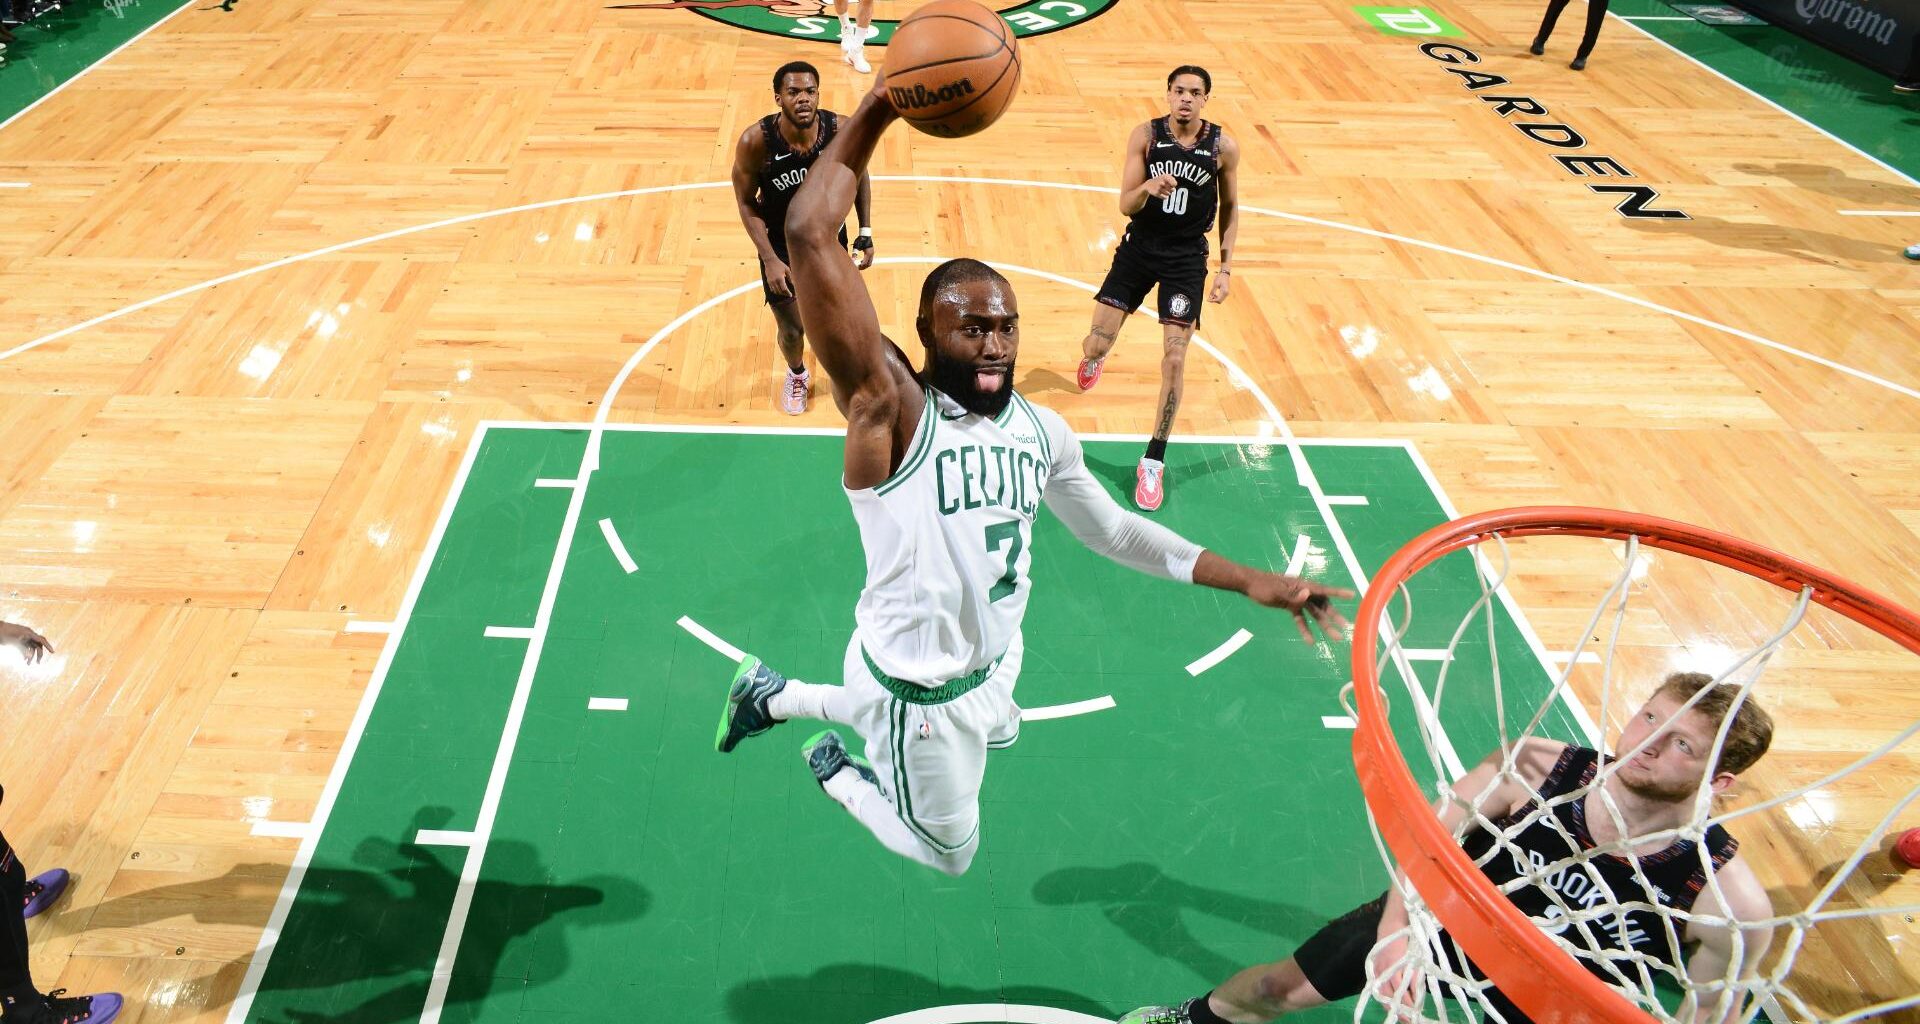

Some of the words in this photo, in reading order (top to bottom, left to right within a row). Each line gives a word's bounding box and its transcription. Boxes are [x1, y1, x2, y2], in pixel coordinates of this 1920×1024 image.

[1795, 0, 1897, 45] Corona
[888, 77, 975, 110] Wilson
[1418, 42, 1694, 221] GARDEN
[1149, 160, 1212, 187] BROOKLYN
[936, 445, 1047, 521] CELTICS
[985, 519, 1023, 604] 7
